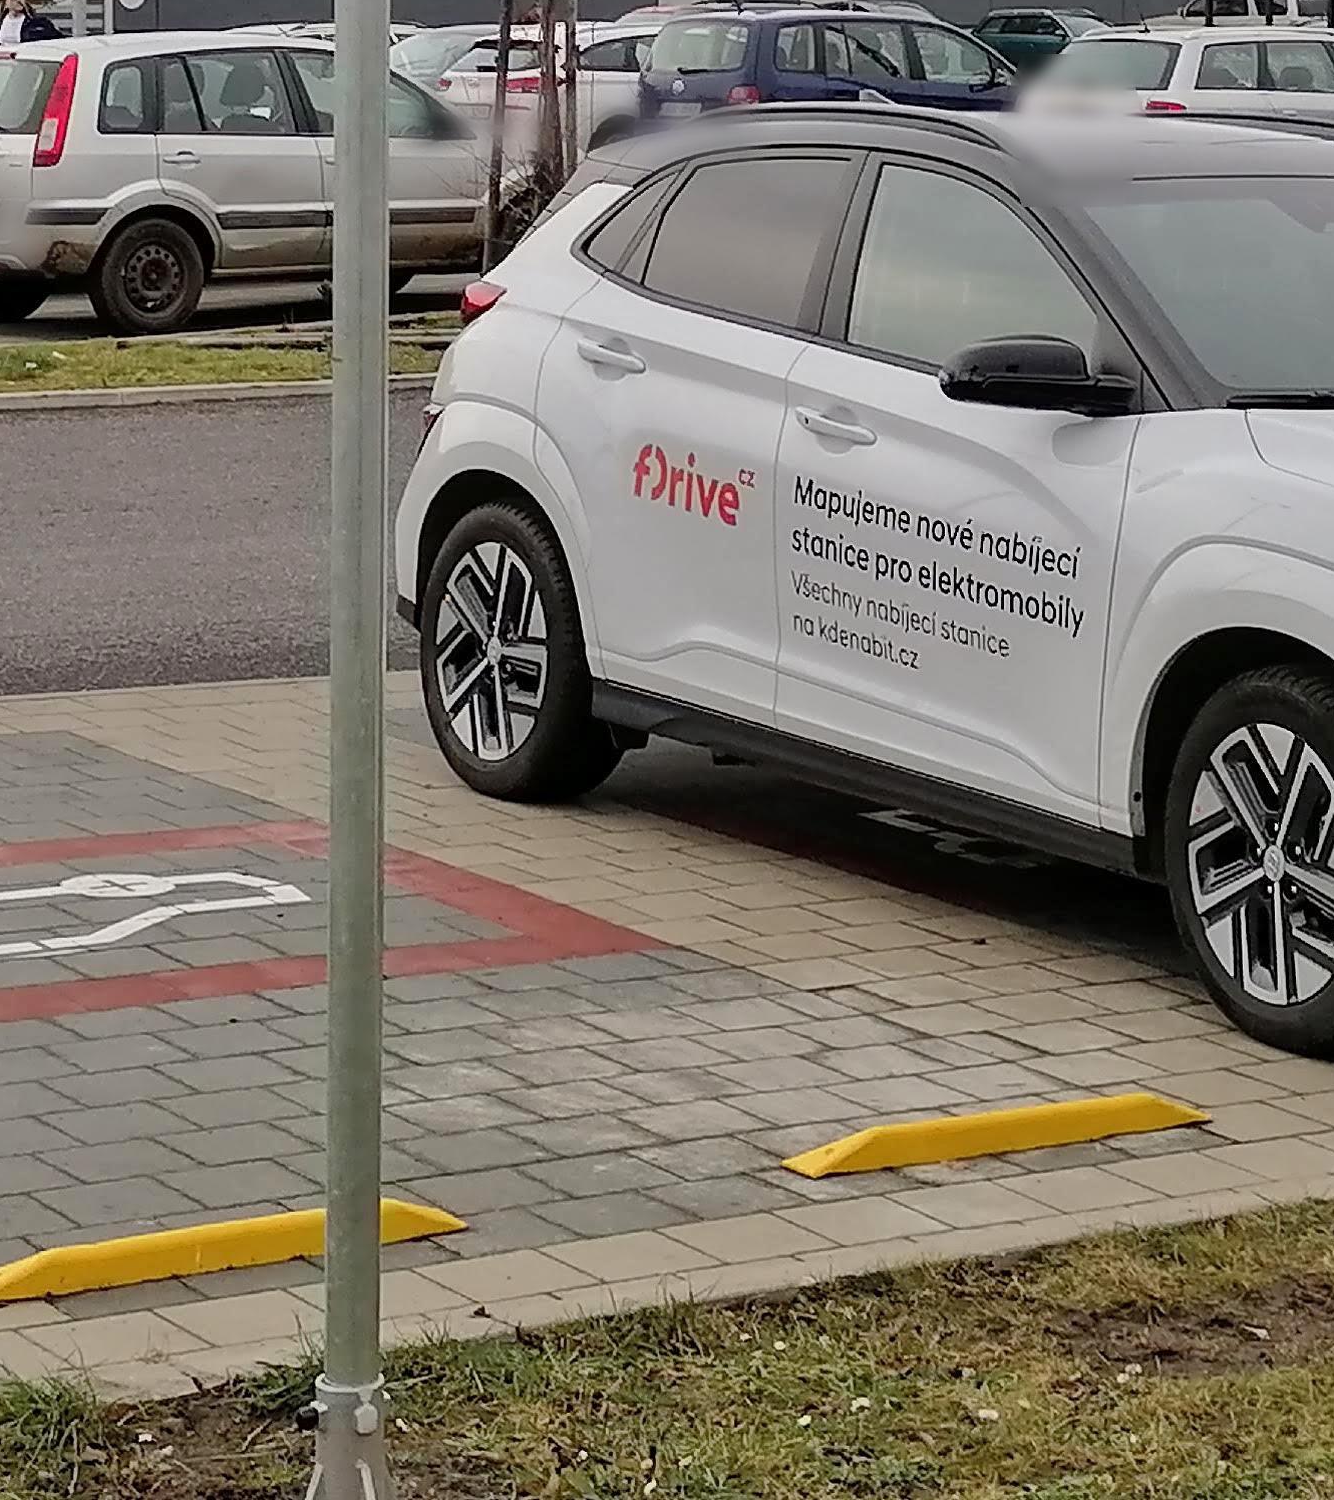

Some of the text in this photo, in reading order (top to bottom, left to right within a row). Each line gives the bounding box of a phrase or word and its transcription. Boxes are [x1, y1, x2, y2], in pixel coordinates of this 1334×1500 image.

[794, 475, 1081, 579] Mapujeme nové nabíjecí
[790, 569, 1010, 657] Všechny nabíjecí stanice
[791, 527, 1084, 638] stanice pro elektromobily
[793, 614, 919, 669] na kdenabit.cz
